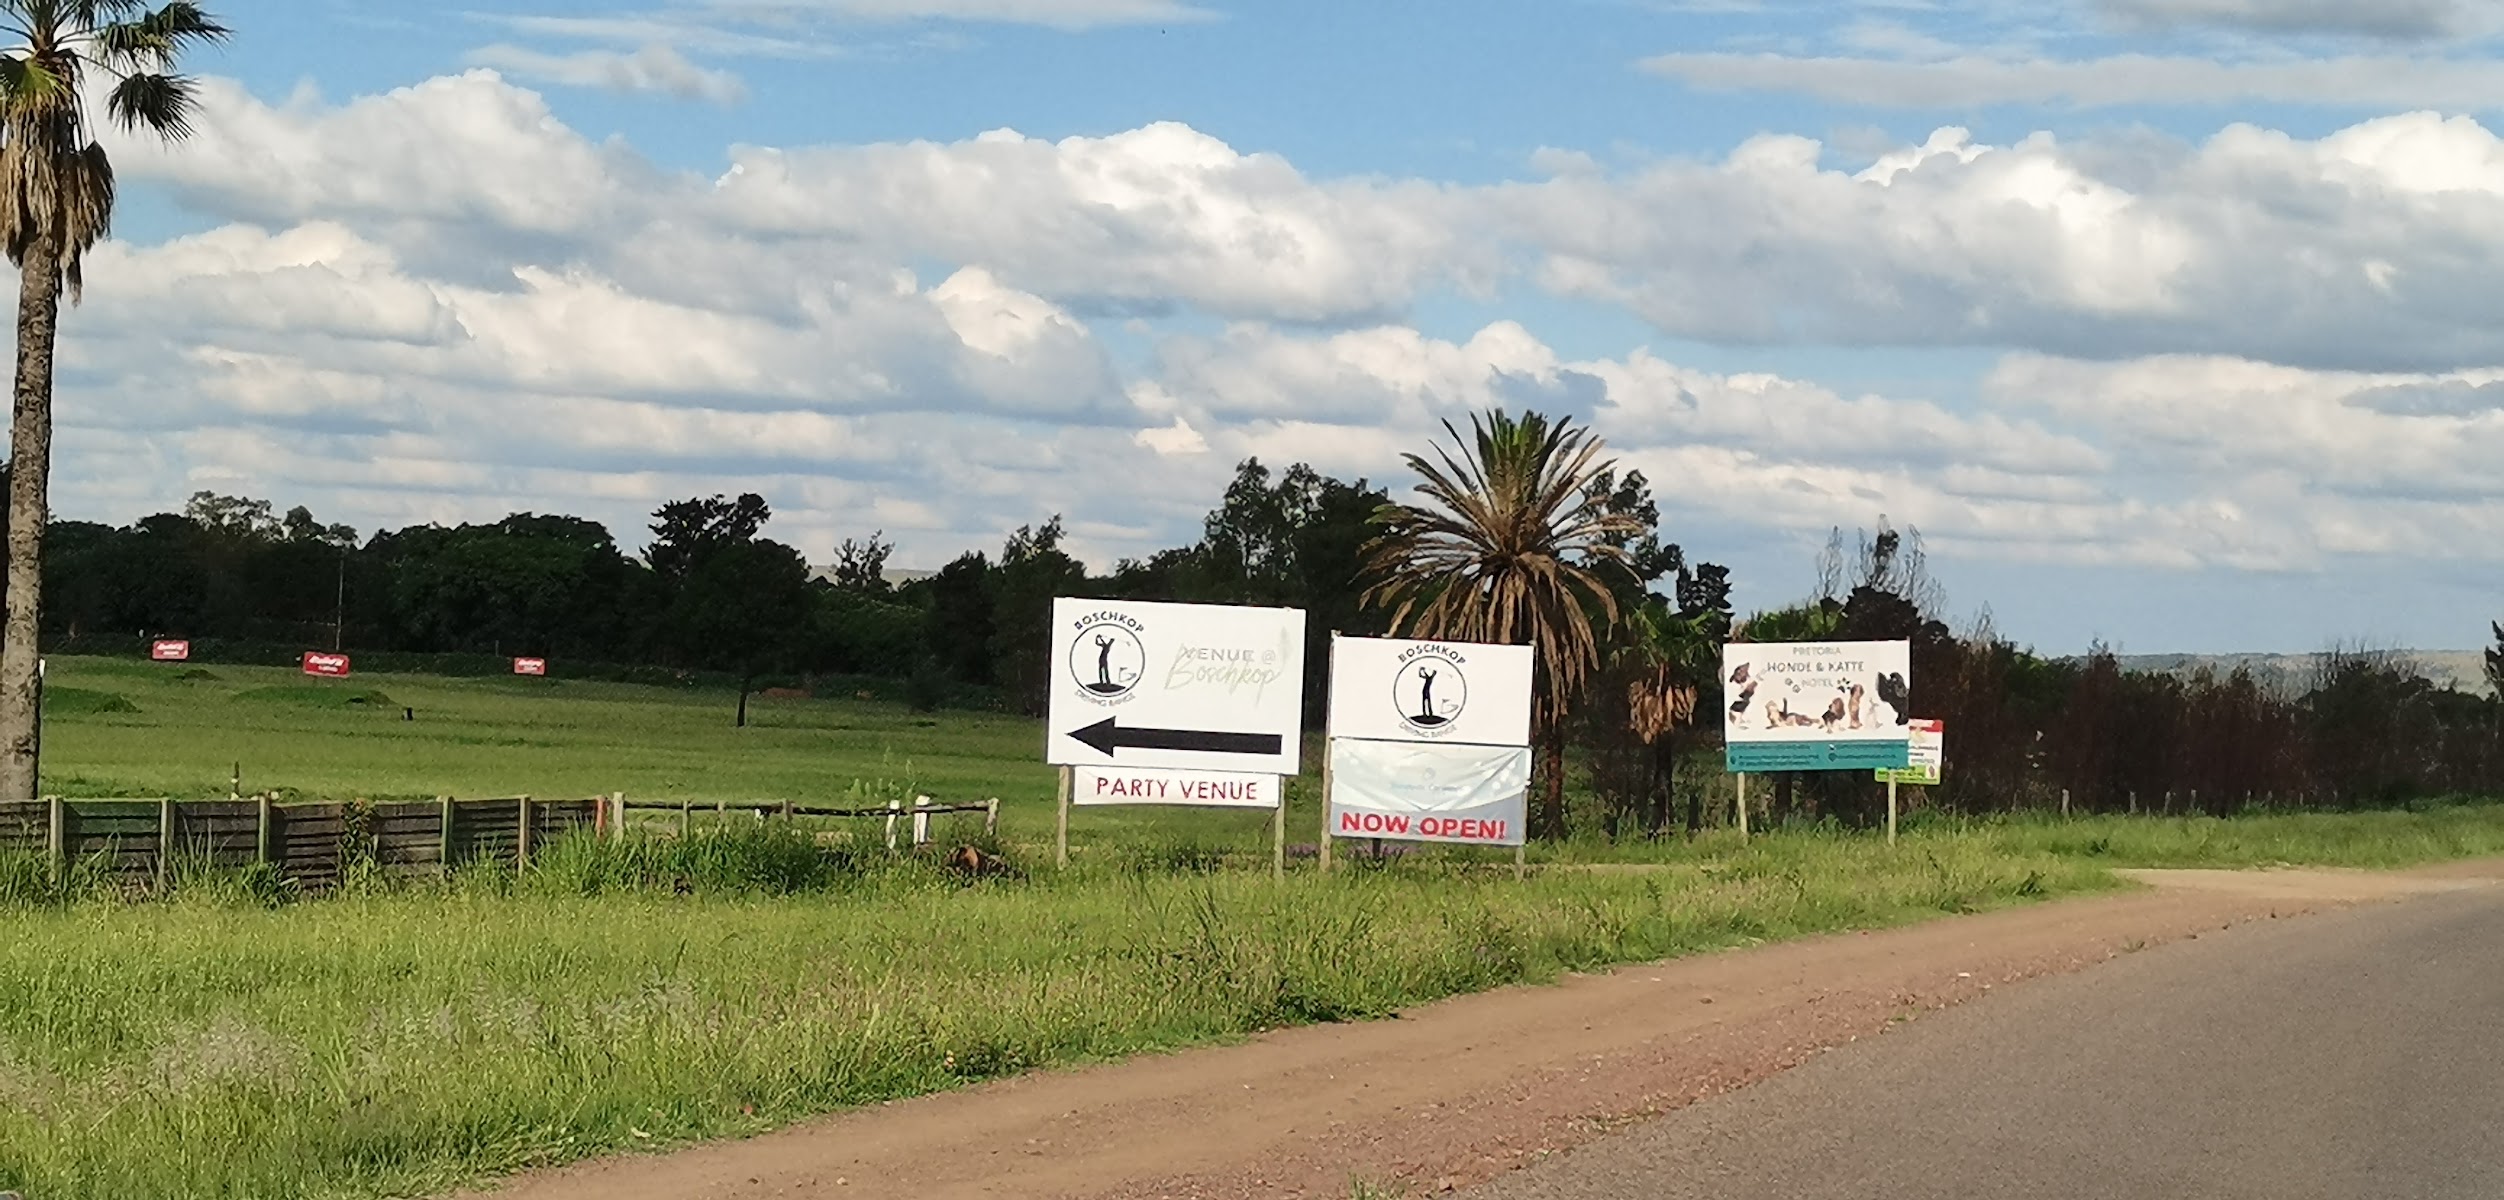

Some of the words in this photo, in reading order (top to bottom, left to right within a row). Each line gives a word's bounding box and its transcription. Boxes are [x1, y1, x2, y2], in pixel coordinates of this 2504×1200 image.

[1074, 610, 1145, 633] BOSCHKOP
[1397, 644, 1467, 665] BOSCHKOP
[1793, 646, 1841, 656] PRETORIA
[1163, 643, 1281, 707] Boschkop
[1828, 661, 1864, 672] KATTE
[1096, 777, 1170, 798] PARTY
[1180, 779, 1258, 800] VENUE
[1341, 811, 1410, 834] NOW
[1419, 816, 1506, 840] OPEN!
